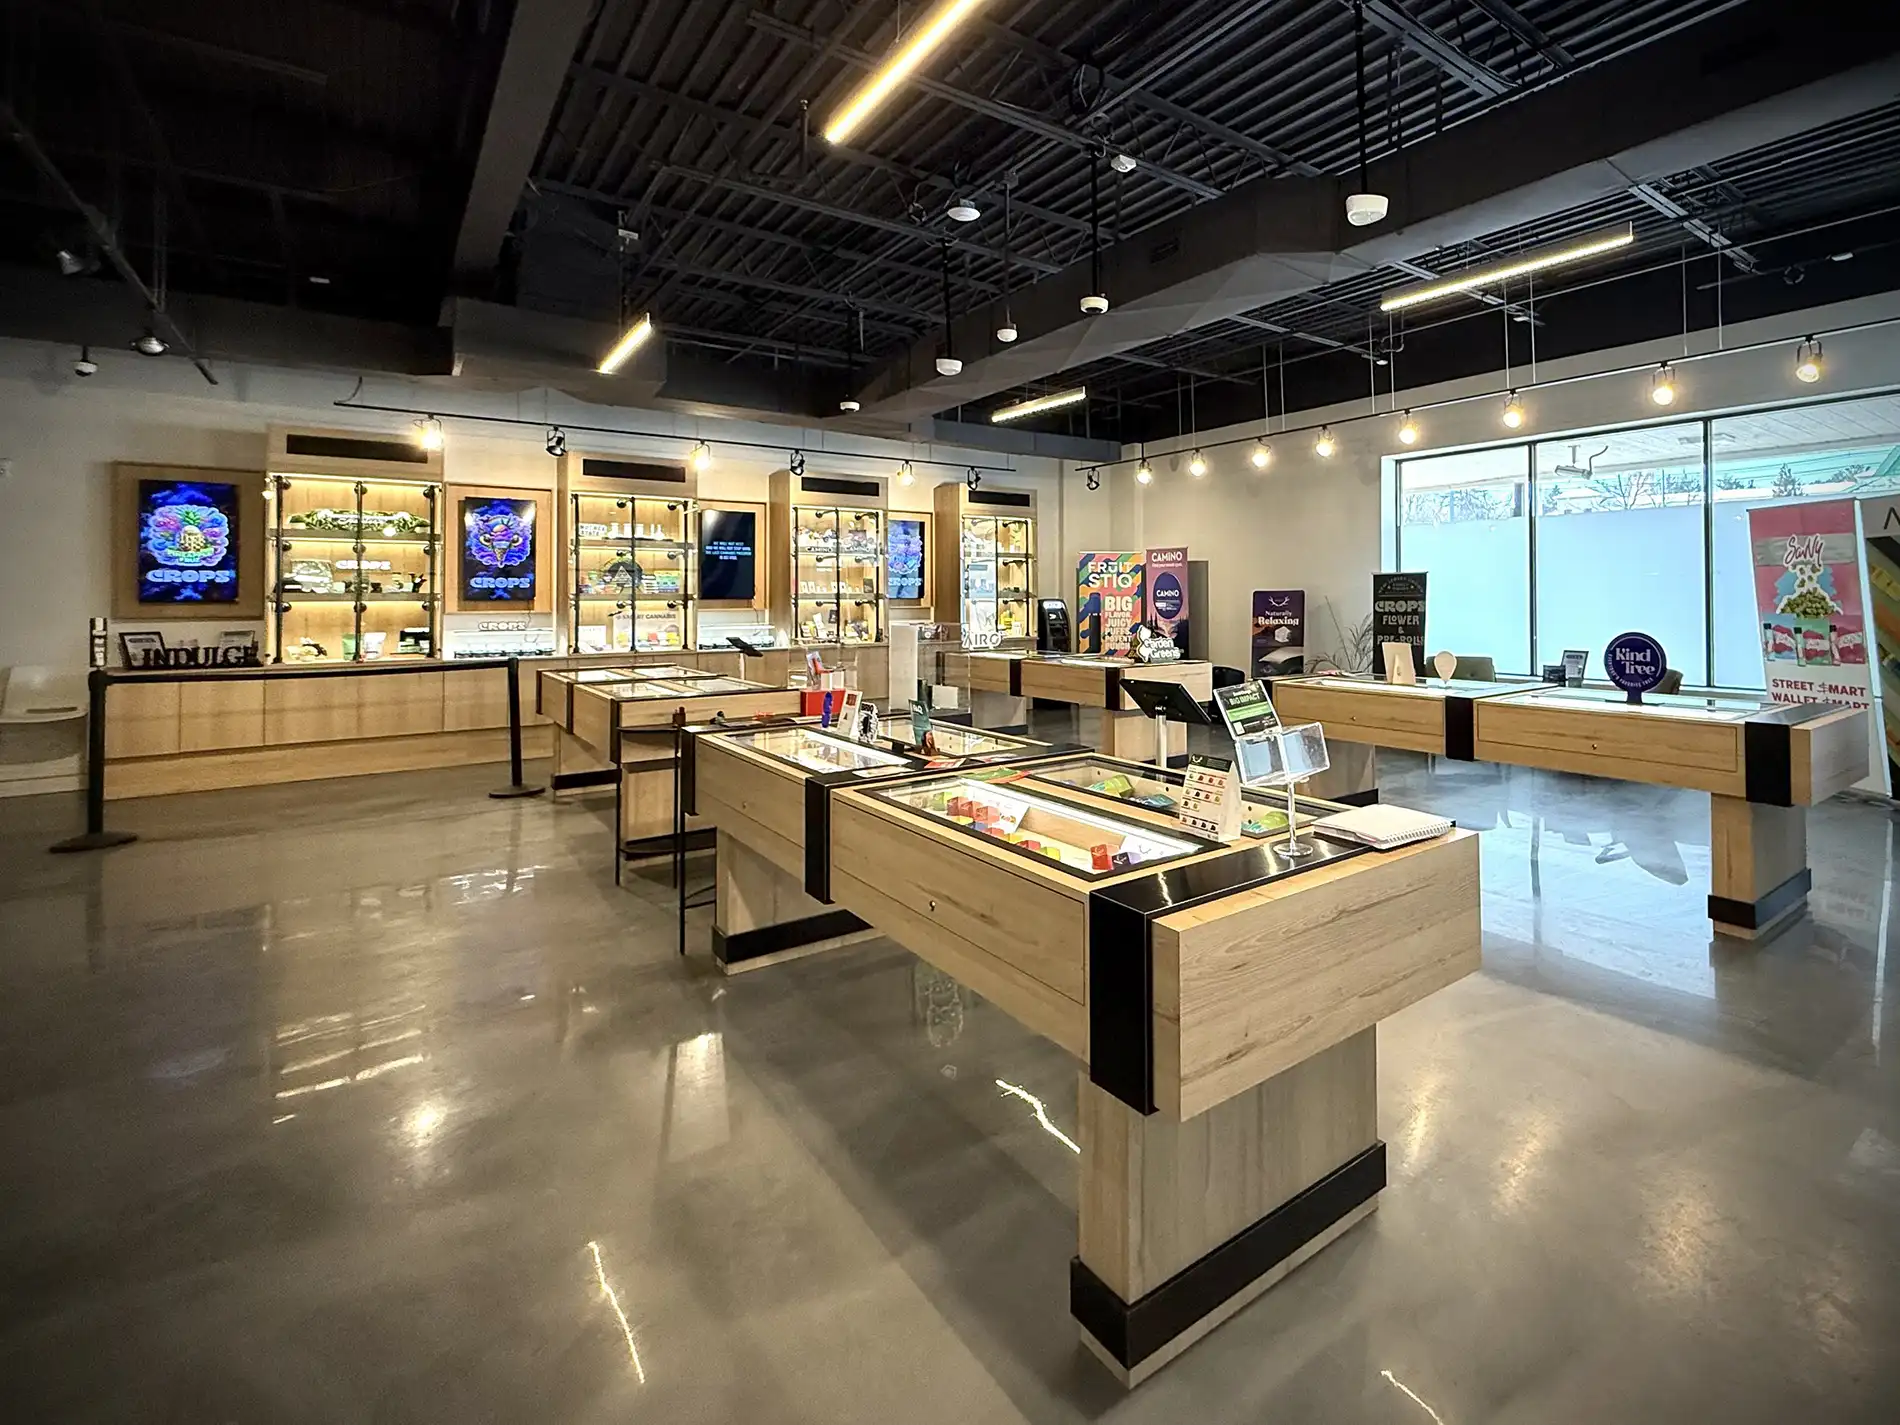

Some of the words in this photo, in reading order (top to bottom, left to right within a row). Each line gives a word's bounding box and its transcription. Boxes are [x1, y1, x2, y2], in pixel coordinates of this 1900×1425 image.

[1151, 551, 1183, 562] CAMINO
[336, 560, 391, 570] CROPS
[1088, 561, 1133, 573] FRUIT
[146, 569, 231, 583] CROPS
[1088, 573, 1133, 588] STIQ
[470, 577, 530, 588] CROPS
[1104, 596, 1132, 611] BIG
[1374, 600, 1425, 612] CROPS
[1104, 618, 1132, 627] JUICY
[1258, 616, 1299, 626] Relaxing
[1382, 614, 1420, 625] FLOWER
[478, 622, 527, 632] CROPS
[1397, 626, 1404, 634] &
[963, 633, 1001, 647] AIRO
[1143, 637, 1175, 648] Garden
[141, 646, 261, 670] INDULGE
[1615, 647, 1651, 662] Kind
[1621, 661, 1656, 675] Tree
[1772, 679, 1814, 691] STREET
[1817, 682, 1867, 697] $MART
[1772, 692, 1818, 704] WALLET
